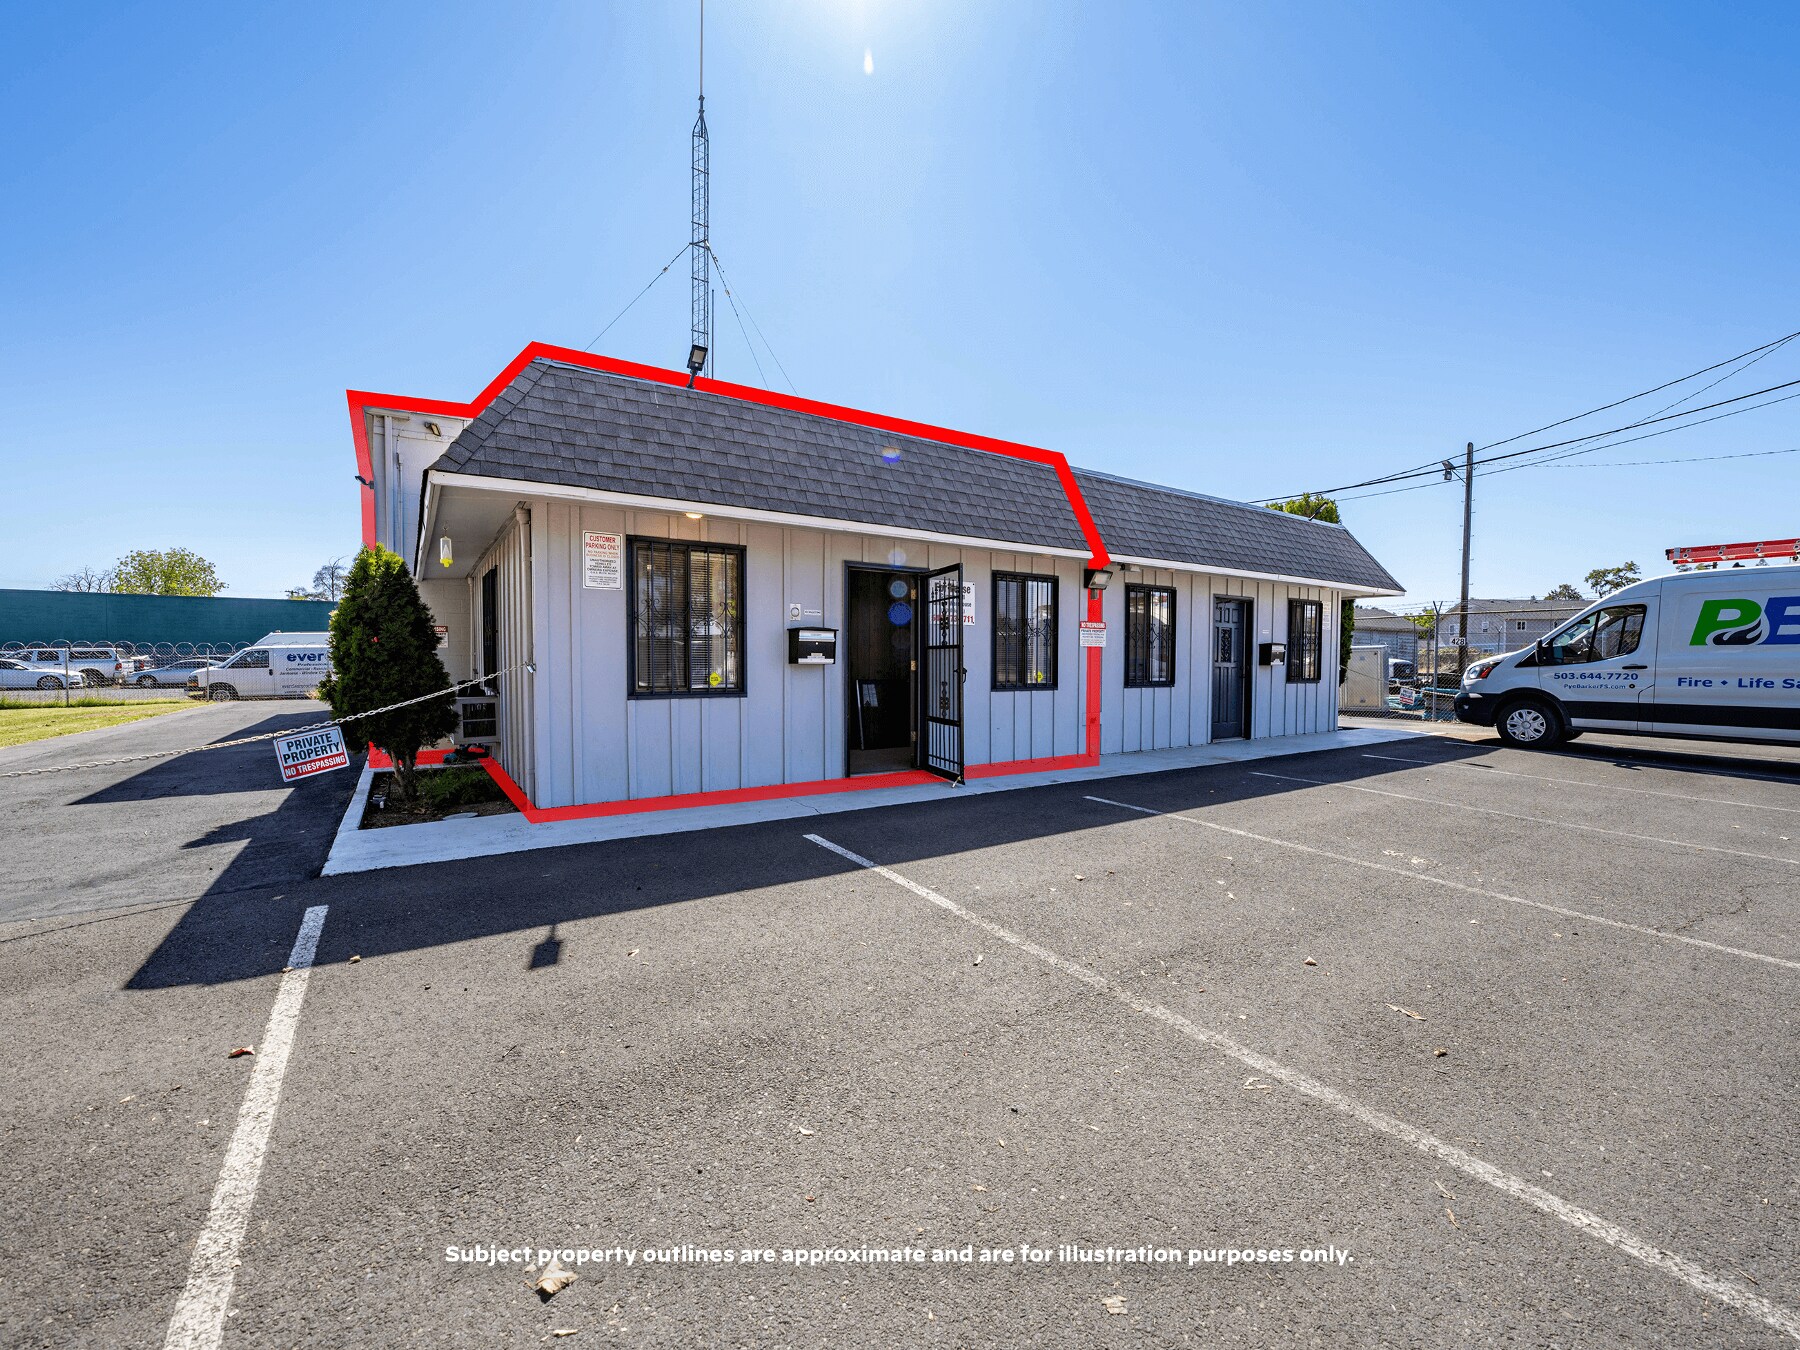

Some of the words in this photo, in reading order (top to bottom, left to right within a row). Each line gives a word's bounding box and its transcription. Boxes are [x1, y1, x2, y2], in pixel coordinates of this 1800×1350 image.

[590, 535, 616, 543] CUSTOMER
[586, 542, 606, 550] PARKING
[1554, 672, 1638, 680] 503.644.7720
[1677, 677, 1712, 687] Fire
[1738, 678, 1775, 688] Life
[286, 733, 333, 752] PRIVATE
[283, 742, 340, 764] PROPERTY
[285, 767, 296, 777] NO
[297, 755, 346, 773] TRESPASSING
